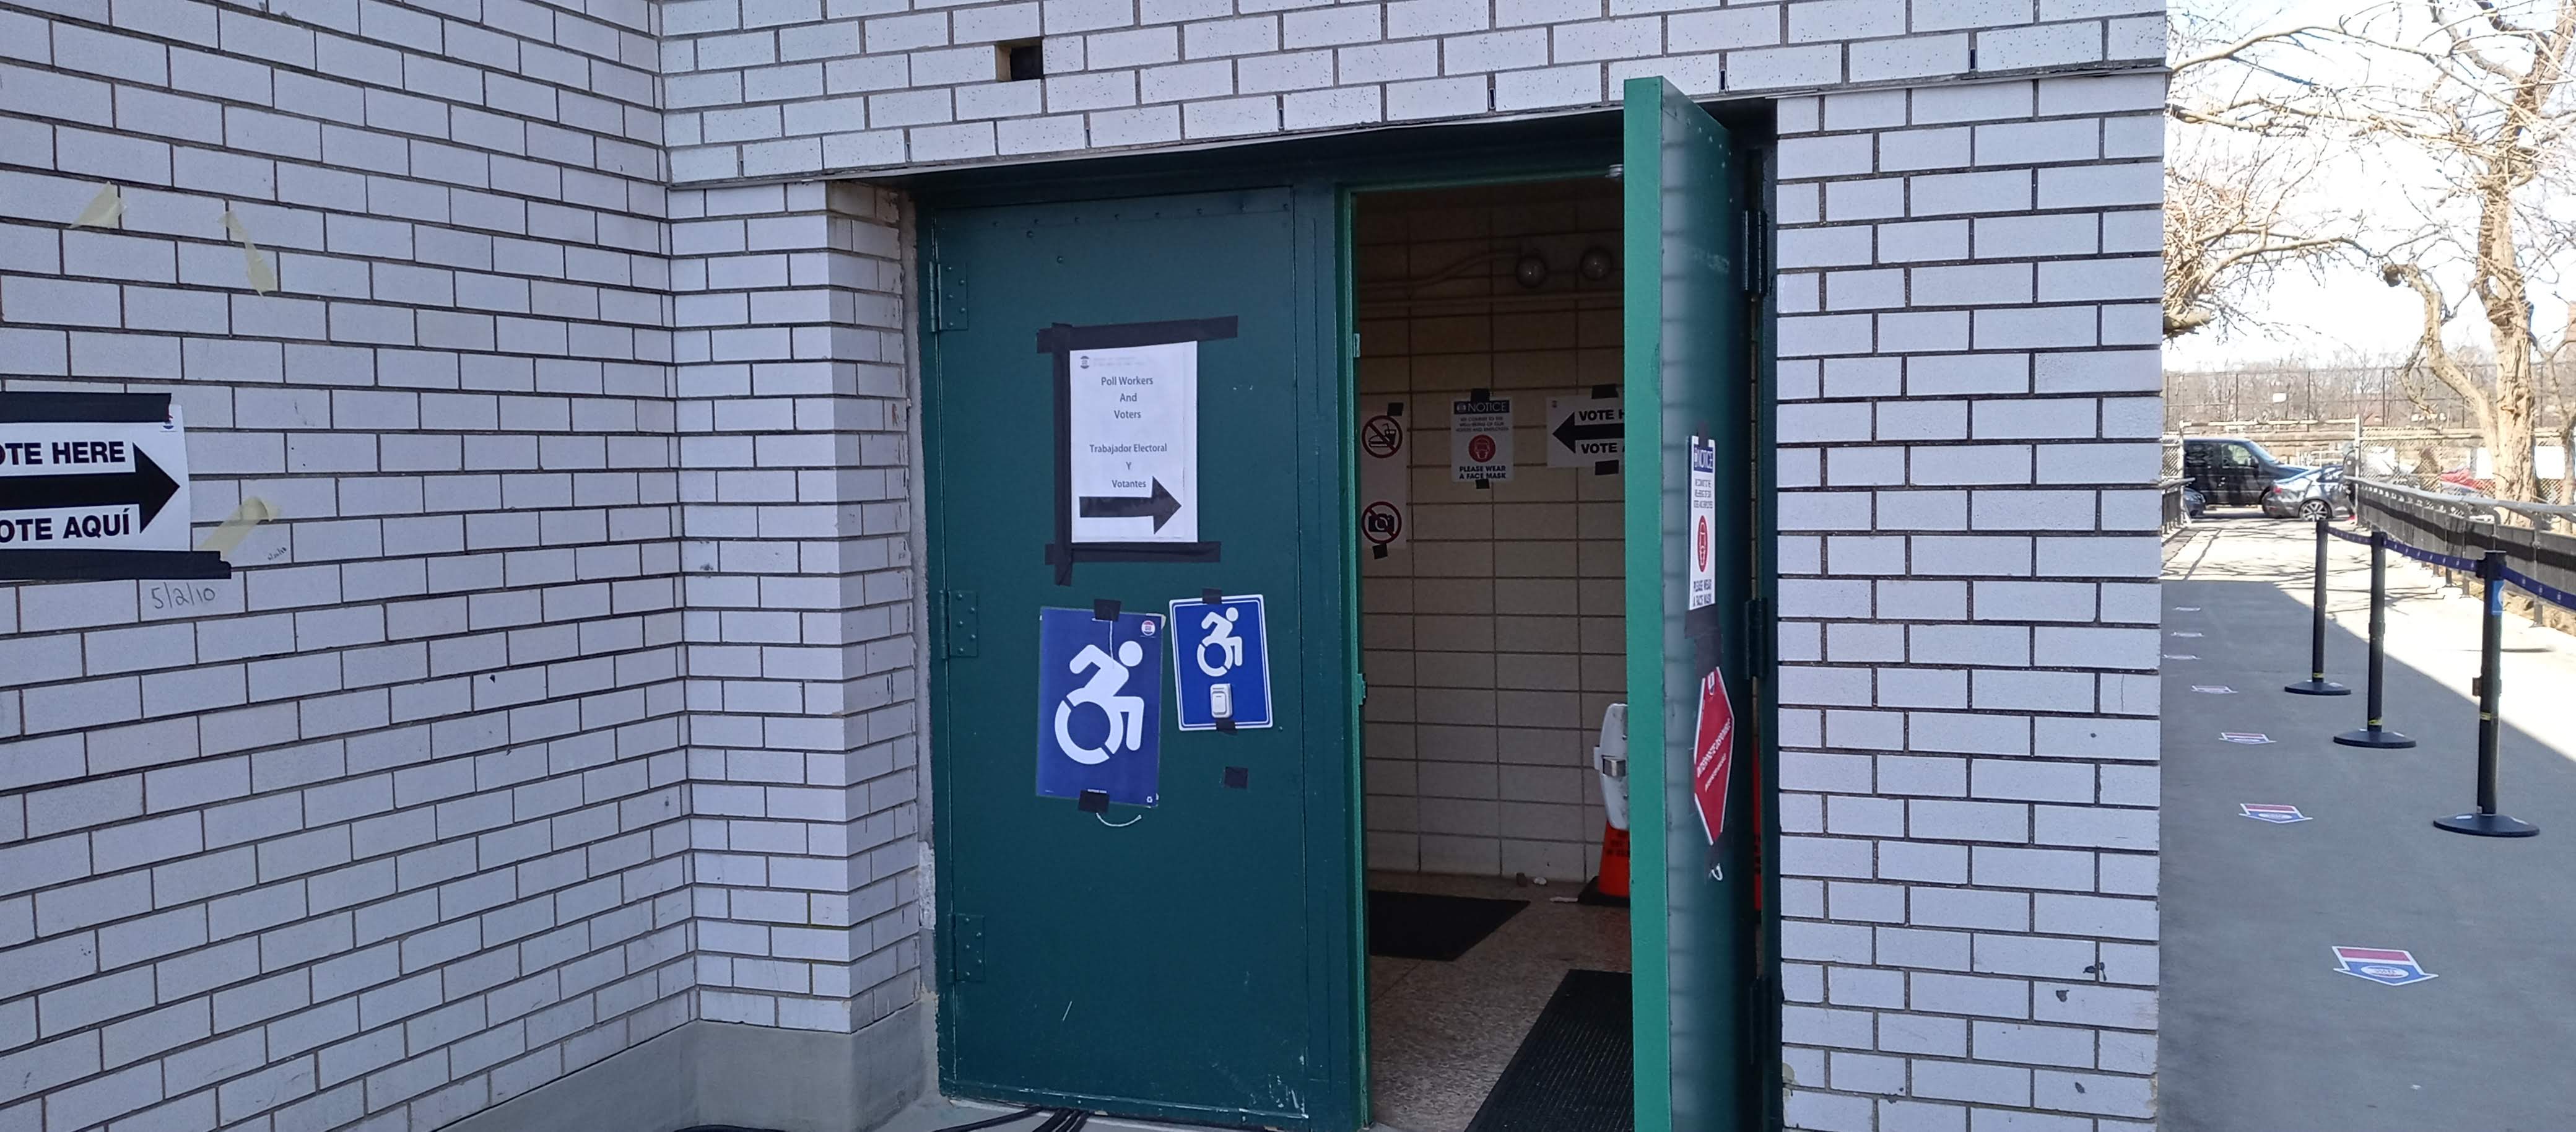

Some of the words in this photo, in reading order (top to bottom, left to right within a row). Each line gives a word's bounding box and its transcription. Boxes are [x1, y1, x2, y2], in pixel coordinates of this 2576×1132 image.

[1101, 376, 1117, 386] Poll
[1118, 376, 1154, 386] Workers
[1120, 393, 1138, 403] And
[1468, 401, 1507, 412] NOTICE
[1114, 409, 1141, 419] Voters
[1579, 409, 1614, 421] VOTE
[52, 442, 126, 464] HERE
[1089, 444, 1132, 455] Trabajador
[1134, 443, 1167, 453] Electoral
[1581, 442, 1617, 454] VOTE
[1126, 461, 1132, 470] Y
[1112, 479, 1146, 488] Votantes
[63, 508, 131, 539] AQUÍ
[151, 581, 216, 610] 5/2/10
